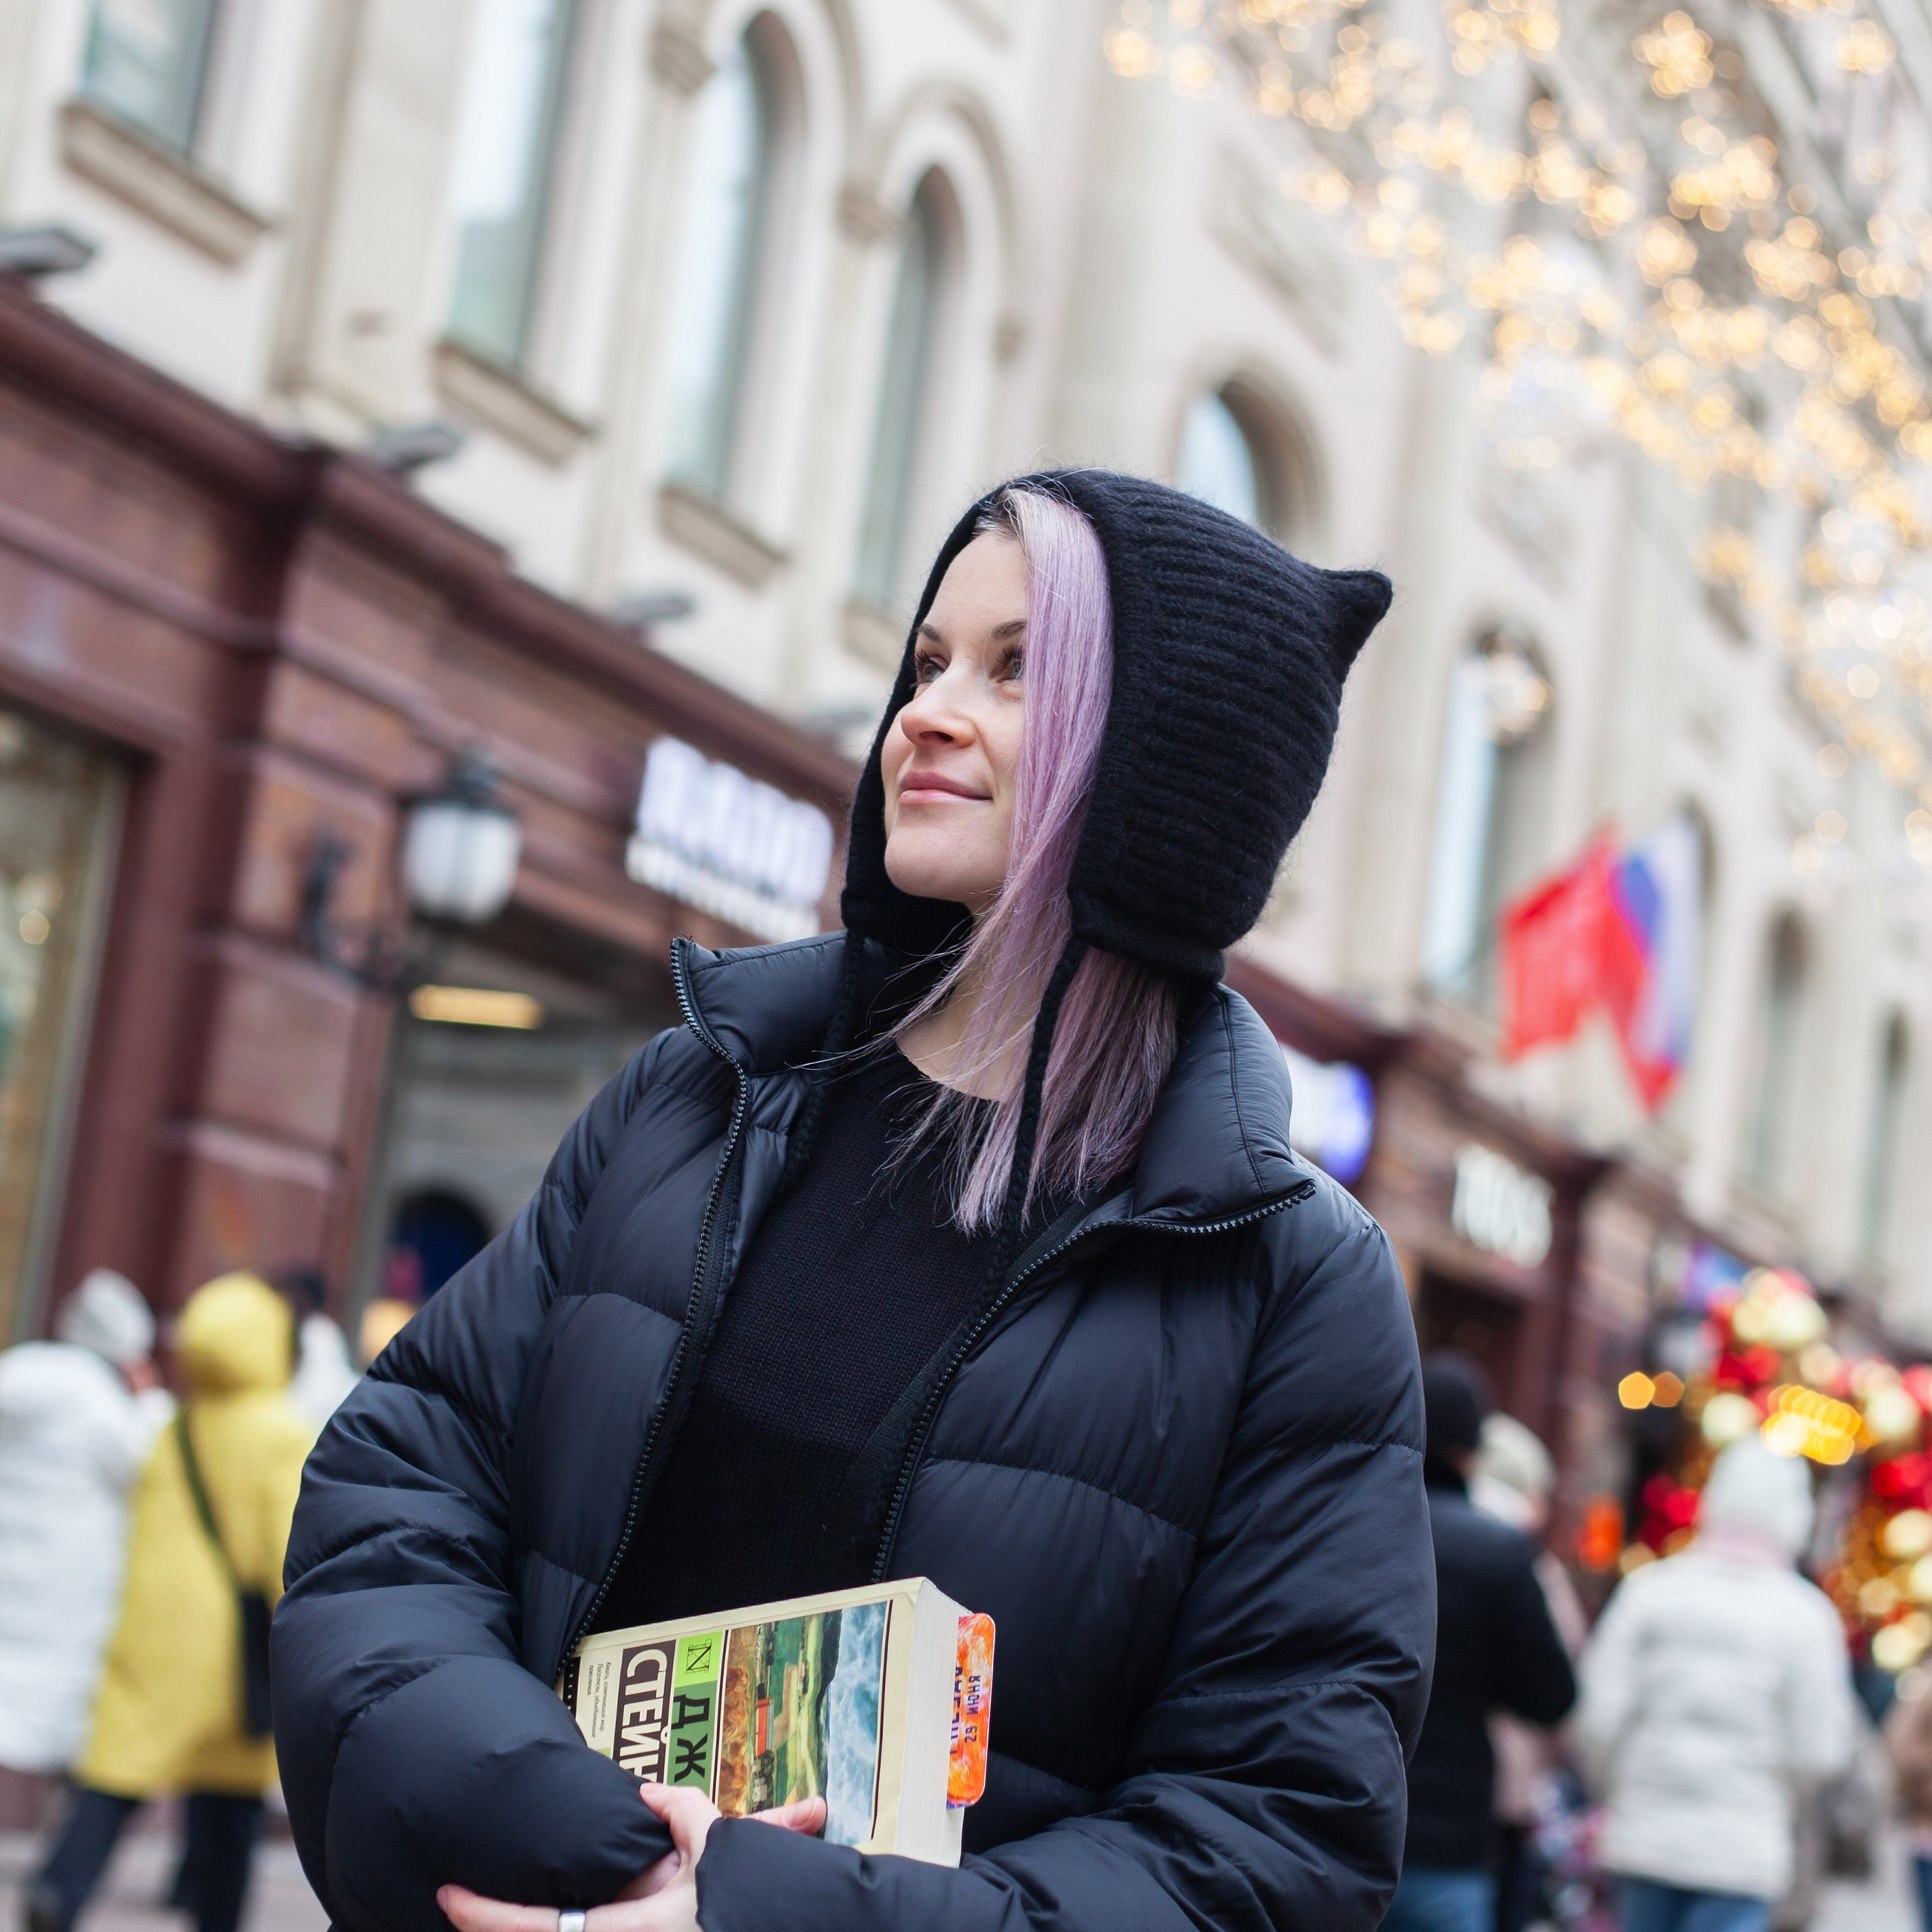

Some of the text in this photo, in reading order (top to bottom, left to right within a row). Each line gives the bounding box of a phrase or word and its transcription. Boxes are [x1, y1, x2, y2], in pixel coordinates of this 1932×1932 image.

[591, 1663, 603, 1738] Писатели, объединившие
[964, 1675, 981, 1743] 29 ИЮНЯ
